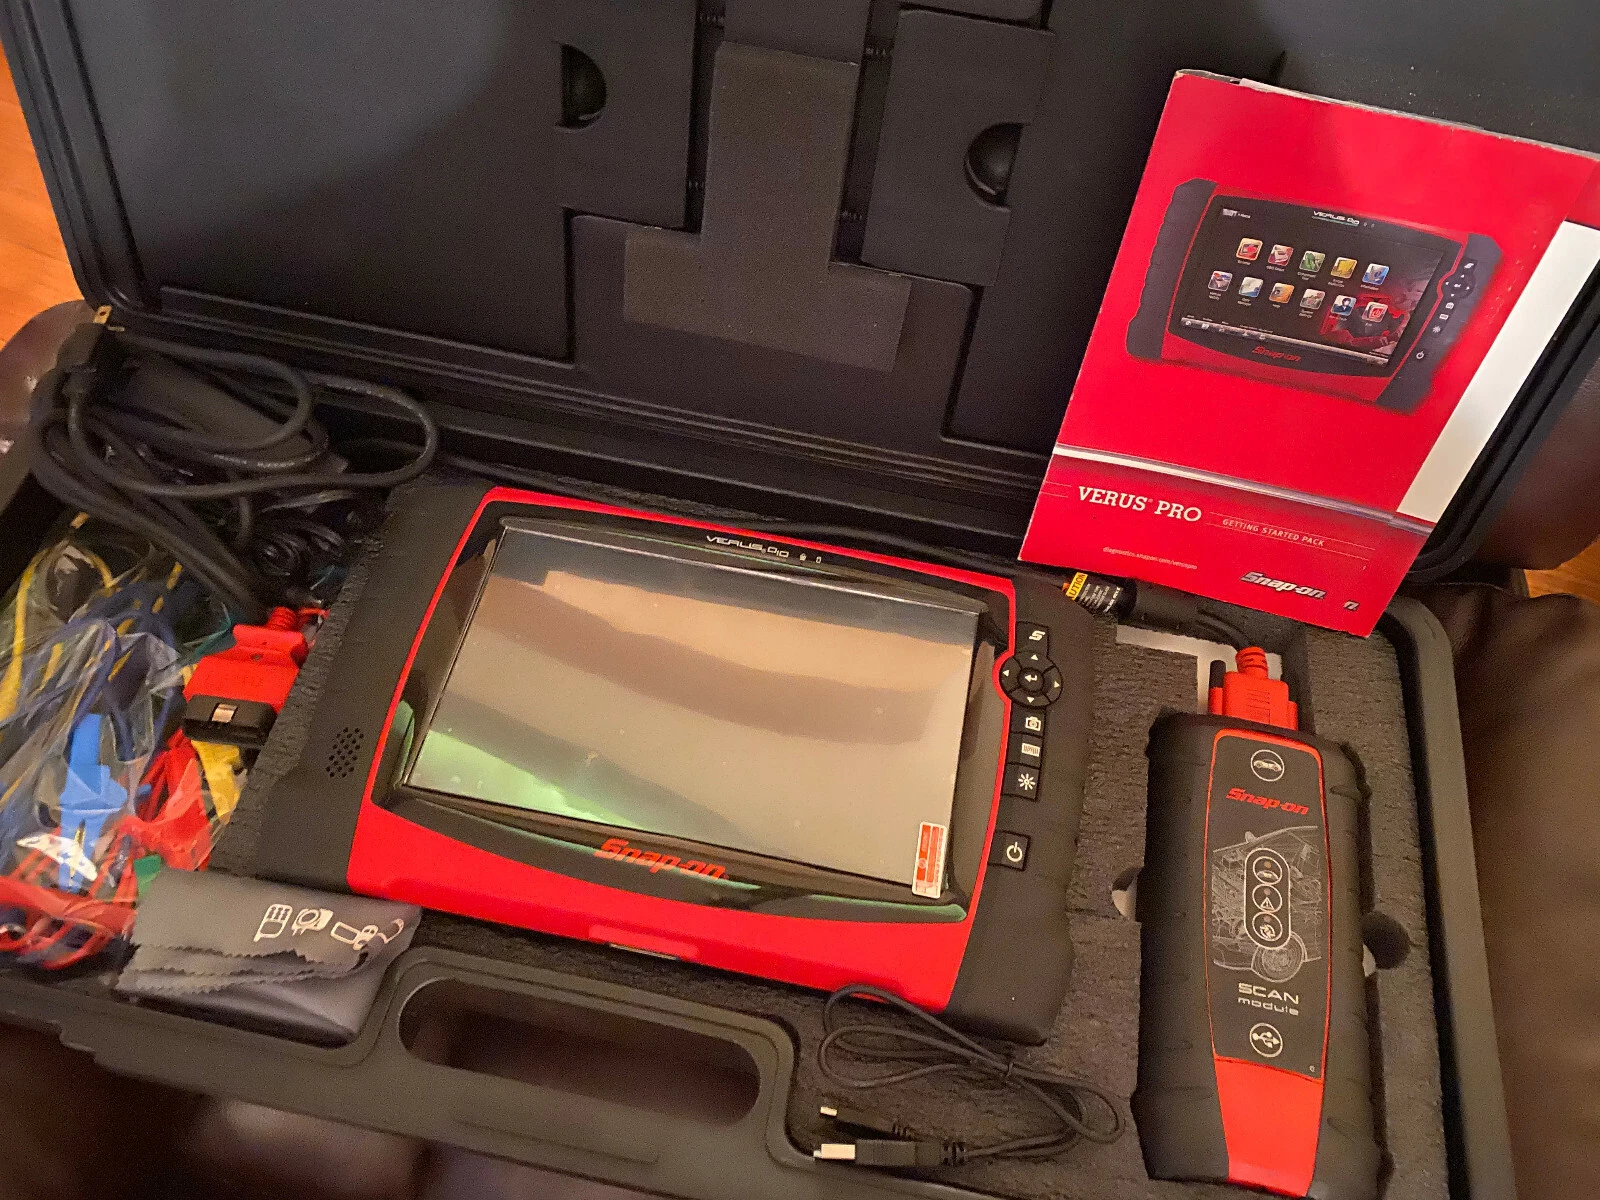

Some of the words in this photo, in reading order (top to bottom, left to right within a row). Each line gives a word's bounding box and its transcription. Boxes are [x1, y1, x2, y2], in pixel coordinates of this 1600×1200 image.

[1154, 500, 1202, 521] PRO
[1222, 518, 1259, 532] GETTING
[1262, 527, 1300, 541] STARTED
[1302, 535, 1325, 547] PACK
[1240, 571, 1326, 600] Snap-on
[1226, 787, 1309, 816] Snap-on
[593, 838, 728, 880] Snap-on
[1237, 996, 1299, 1016] module
[1238, 982, 1299, 1005] SCAN
